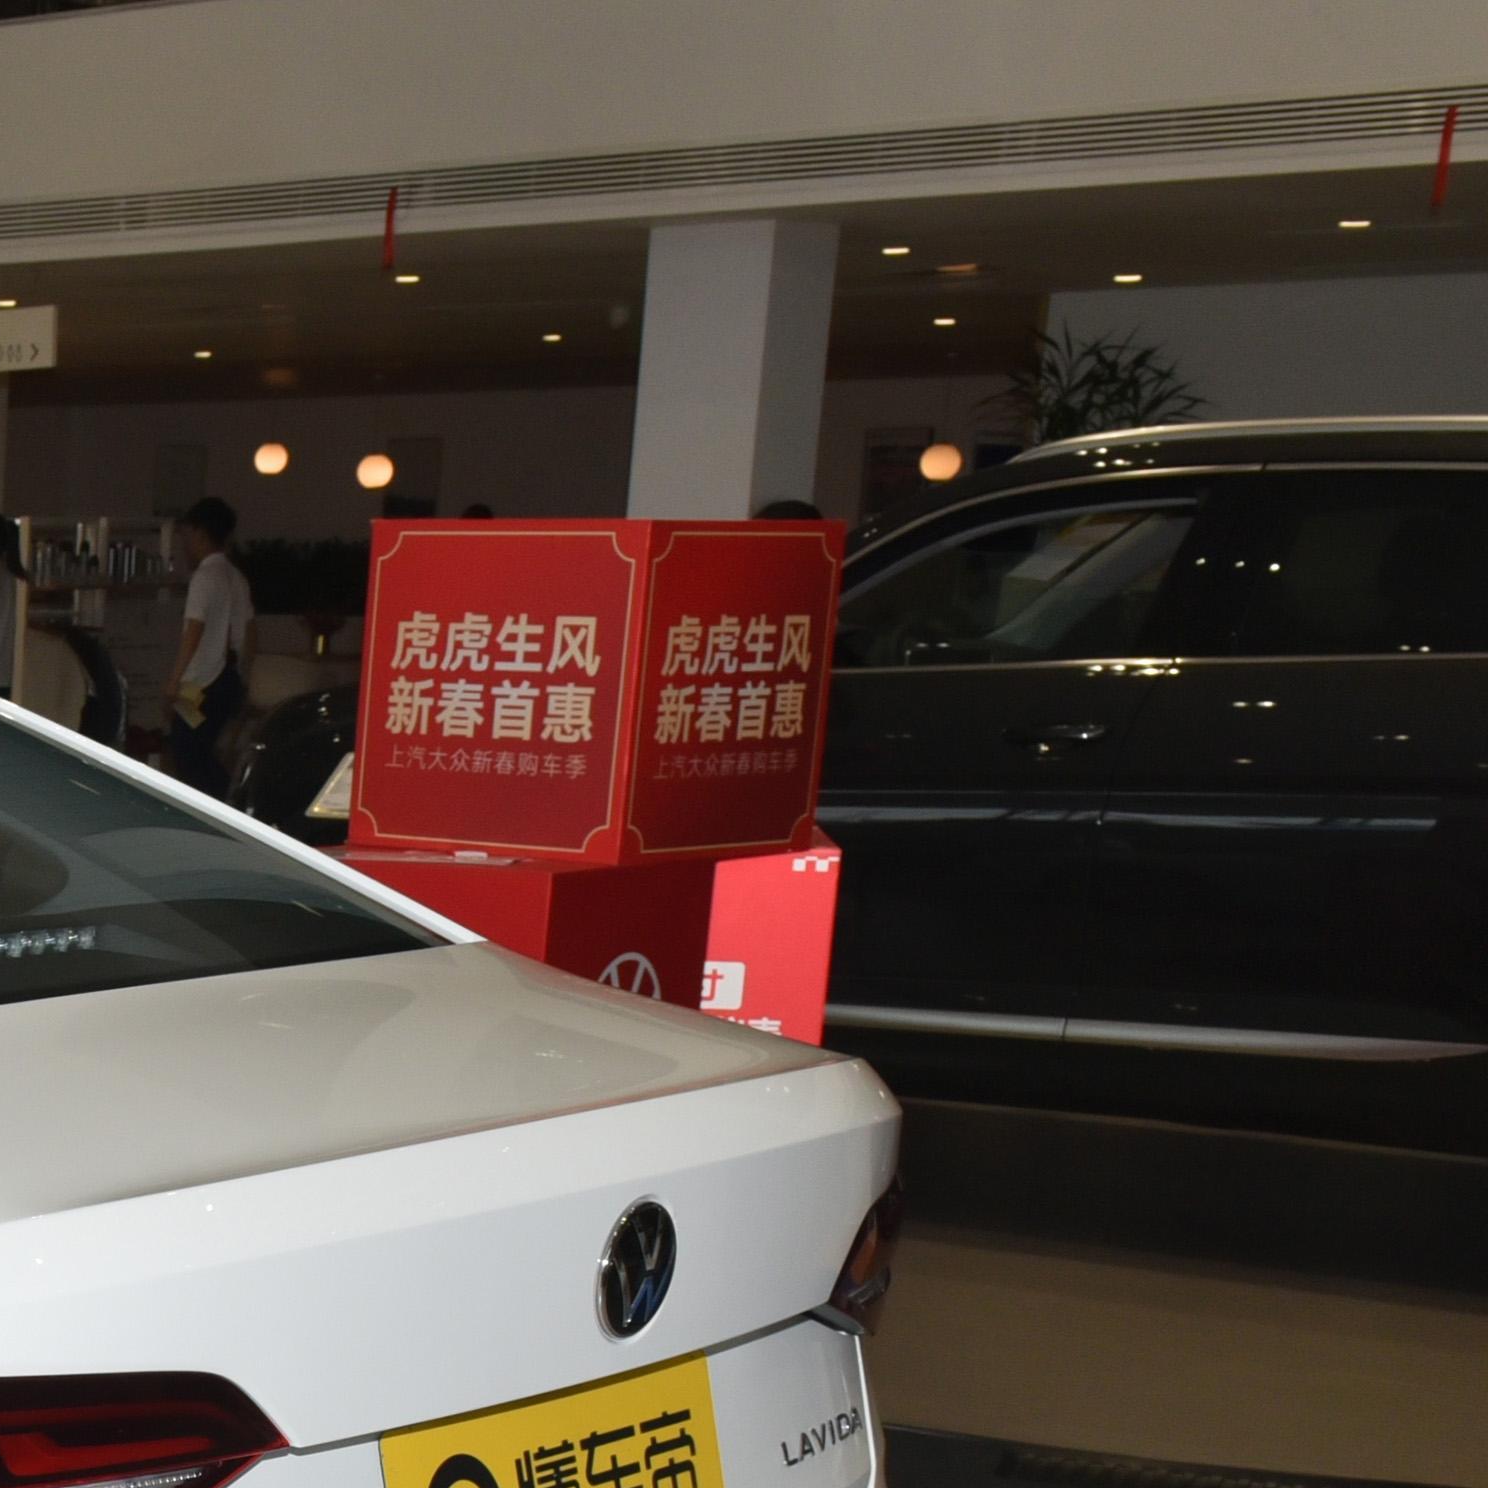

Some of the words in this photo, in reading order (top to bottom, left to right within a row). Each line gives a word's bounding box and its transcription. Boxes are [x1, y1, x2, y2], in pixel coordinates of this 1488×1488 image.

[389, 610, 602, 678] 虎虎生风
[660, 613, 812, 678] 虎虎生风
[384, 675, 597, 744] 新春首惠
[653, 679, 808, 746] 新春首惠
[384, 745, 588, 780] 上汽大众新春购车季
[652, 748, 800, 780] 上汽大众新春购车季
[782, 1407, 862, 1467] LAVIDA
